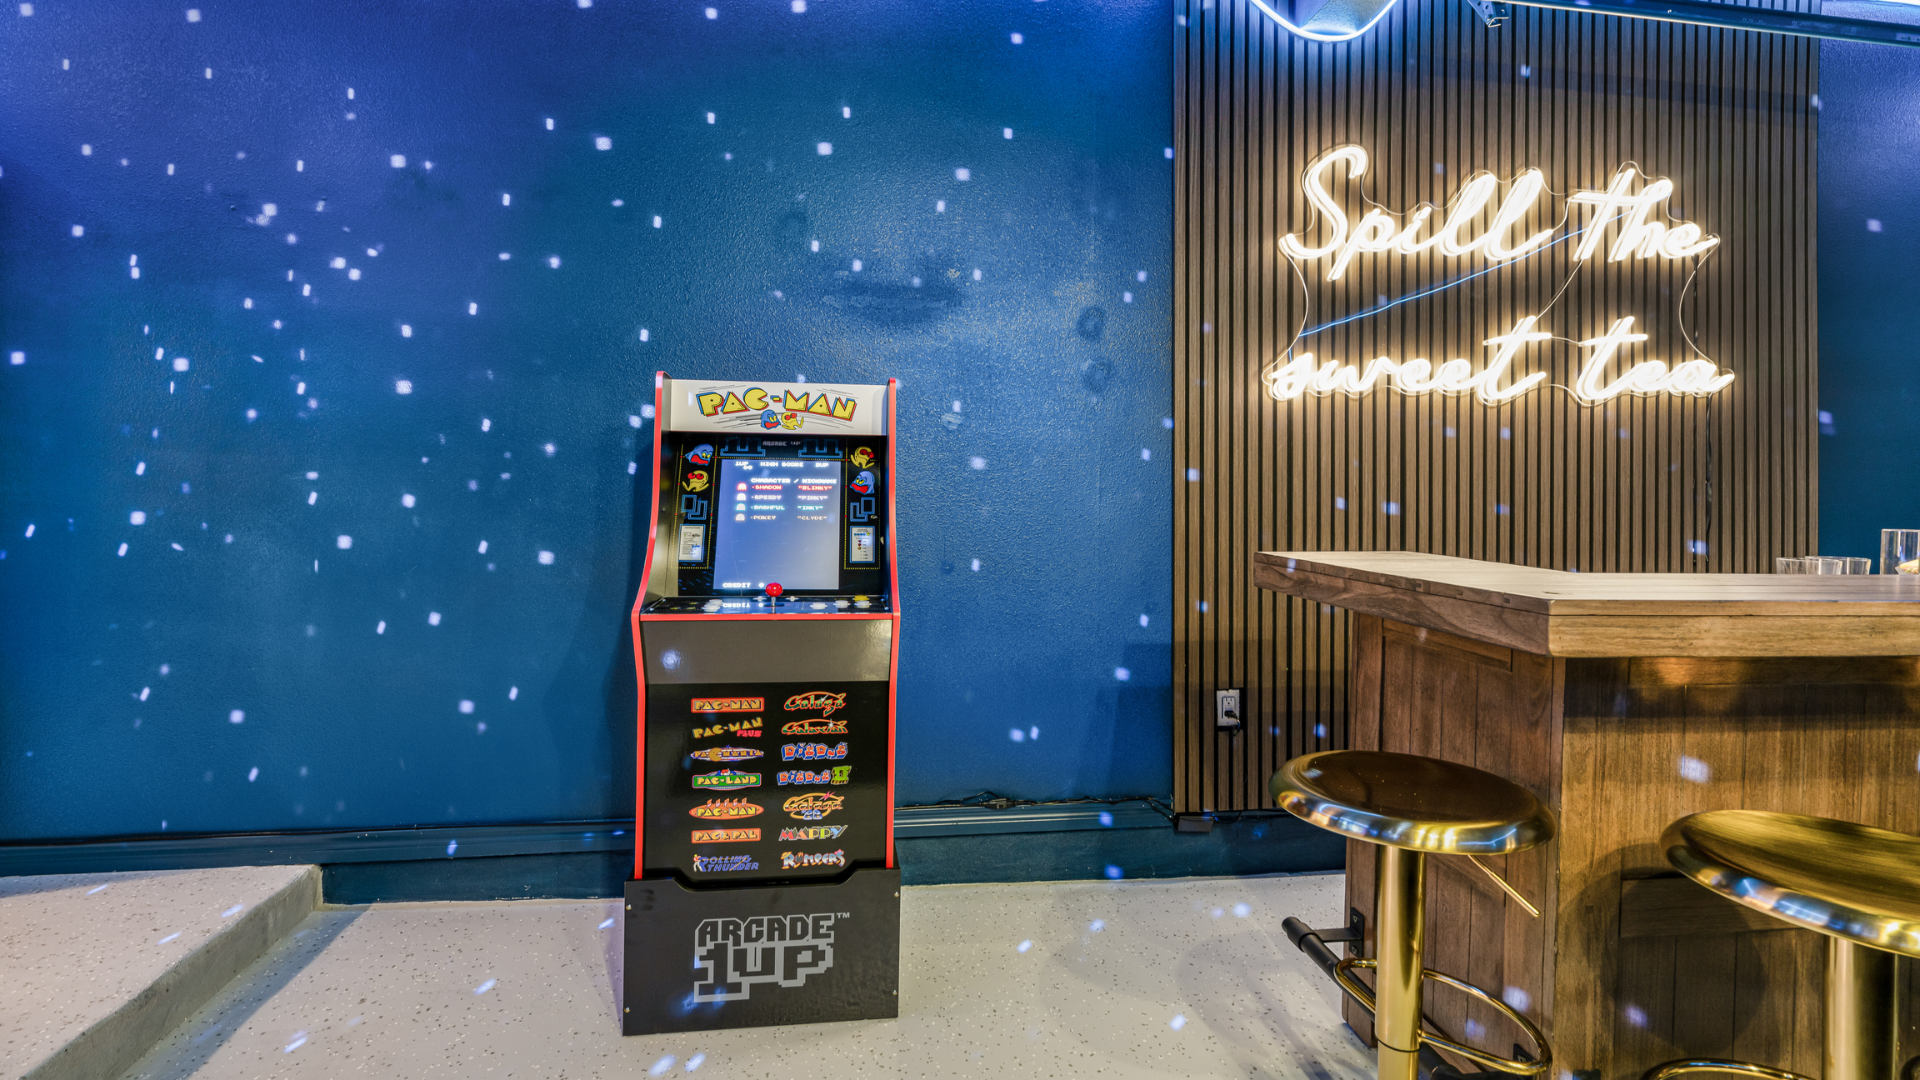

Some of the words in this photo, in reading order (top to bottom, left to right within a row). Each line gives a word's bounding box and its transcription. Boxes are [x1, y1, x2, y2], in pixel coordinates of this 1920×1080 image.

[1279, 145, 1553, 281] Spill
[1268, 315, 1546, 402] sweet
[1577, 315, 1735, 402] tea
[696, 387, 857, 421] PAC-MAN
[750, 477, 791, 485] CHARACTER
[722, 581, 751, 589] CREDIT
[694, 699, 761, 711] PAC-MAN
[692, 717, 763, 739] PAC-MAN
[736, 729, 763, 738] PLUS
[697, 776, 757, 786] PAC-LAND
[697, 807, 757, 817] PAC-MAN
[694, 831, 721, 841] PAC
[731, 829, 758, 839] PAL
[778, 825, 848, 841] MAPPY
[698, 855, 752, 872] ROLLING
[707, 862, 759, 872] THUNDER
[695, 913, 834, 948] ARCADE
[694, 943, 833, 1002] 1UP
